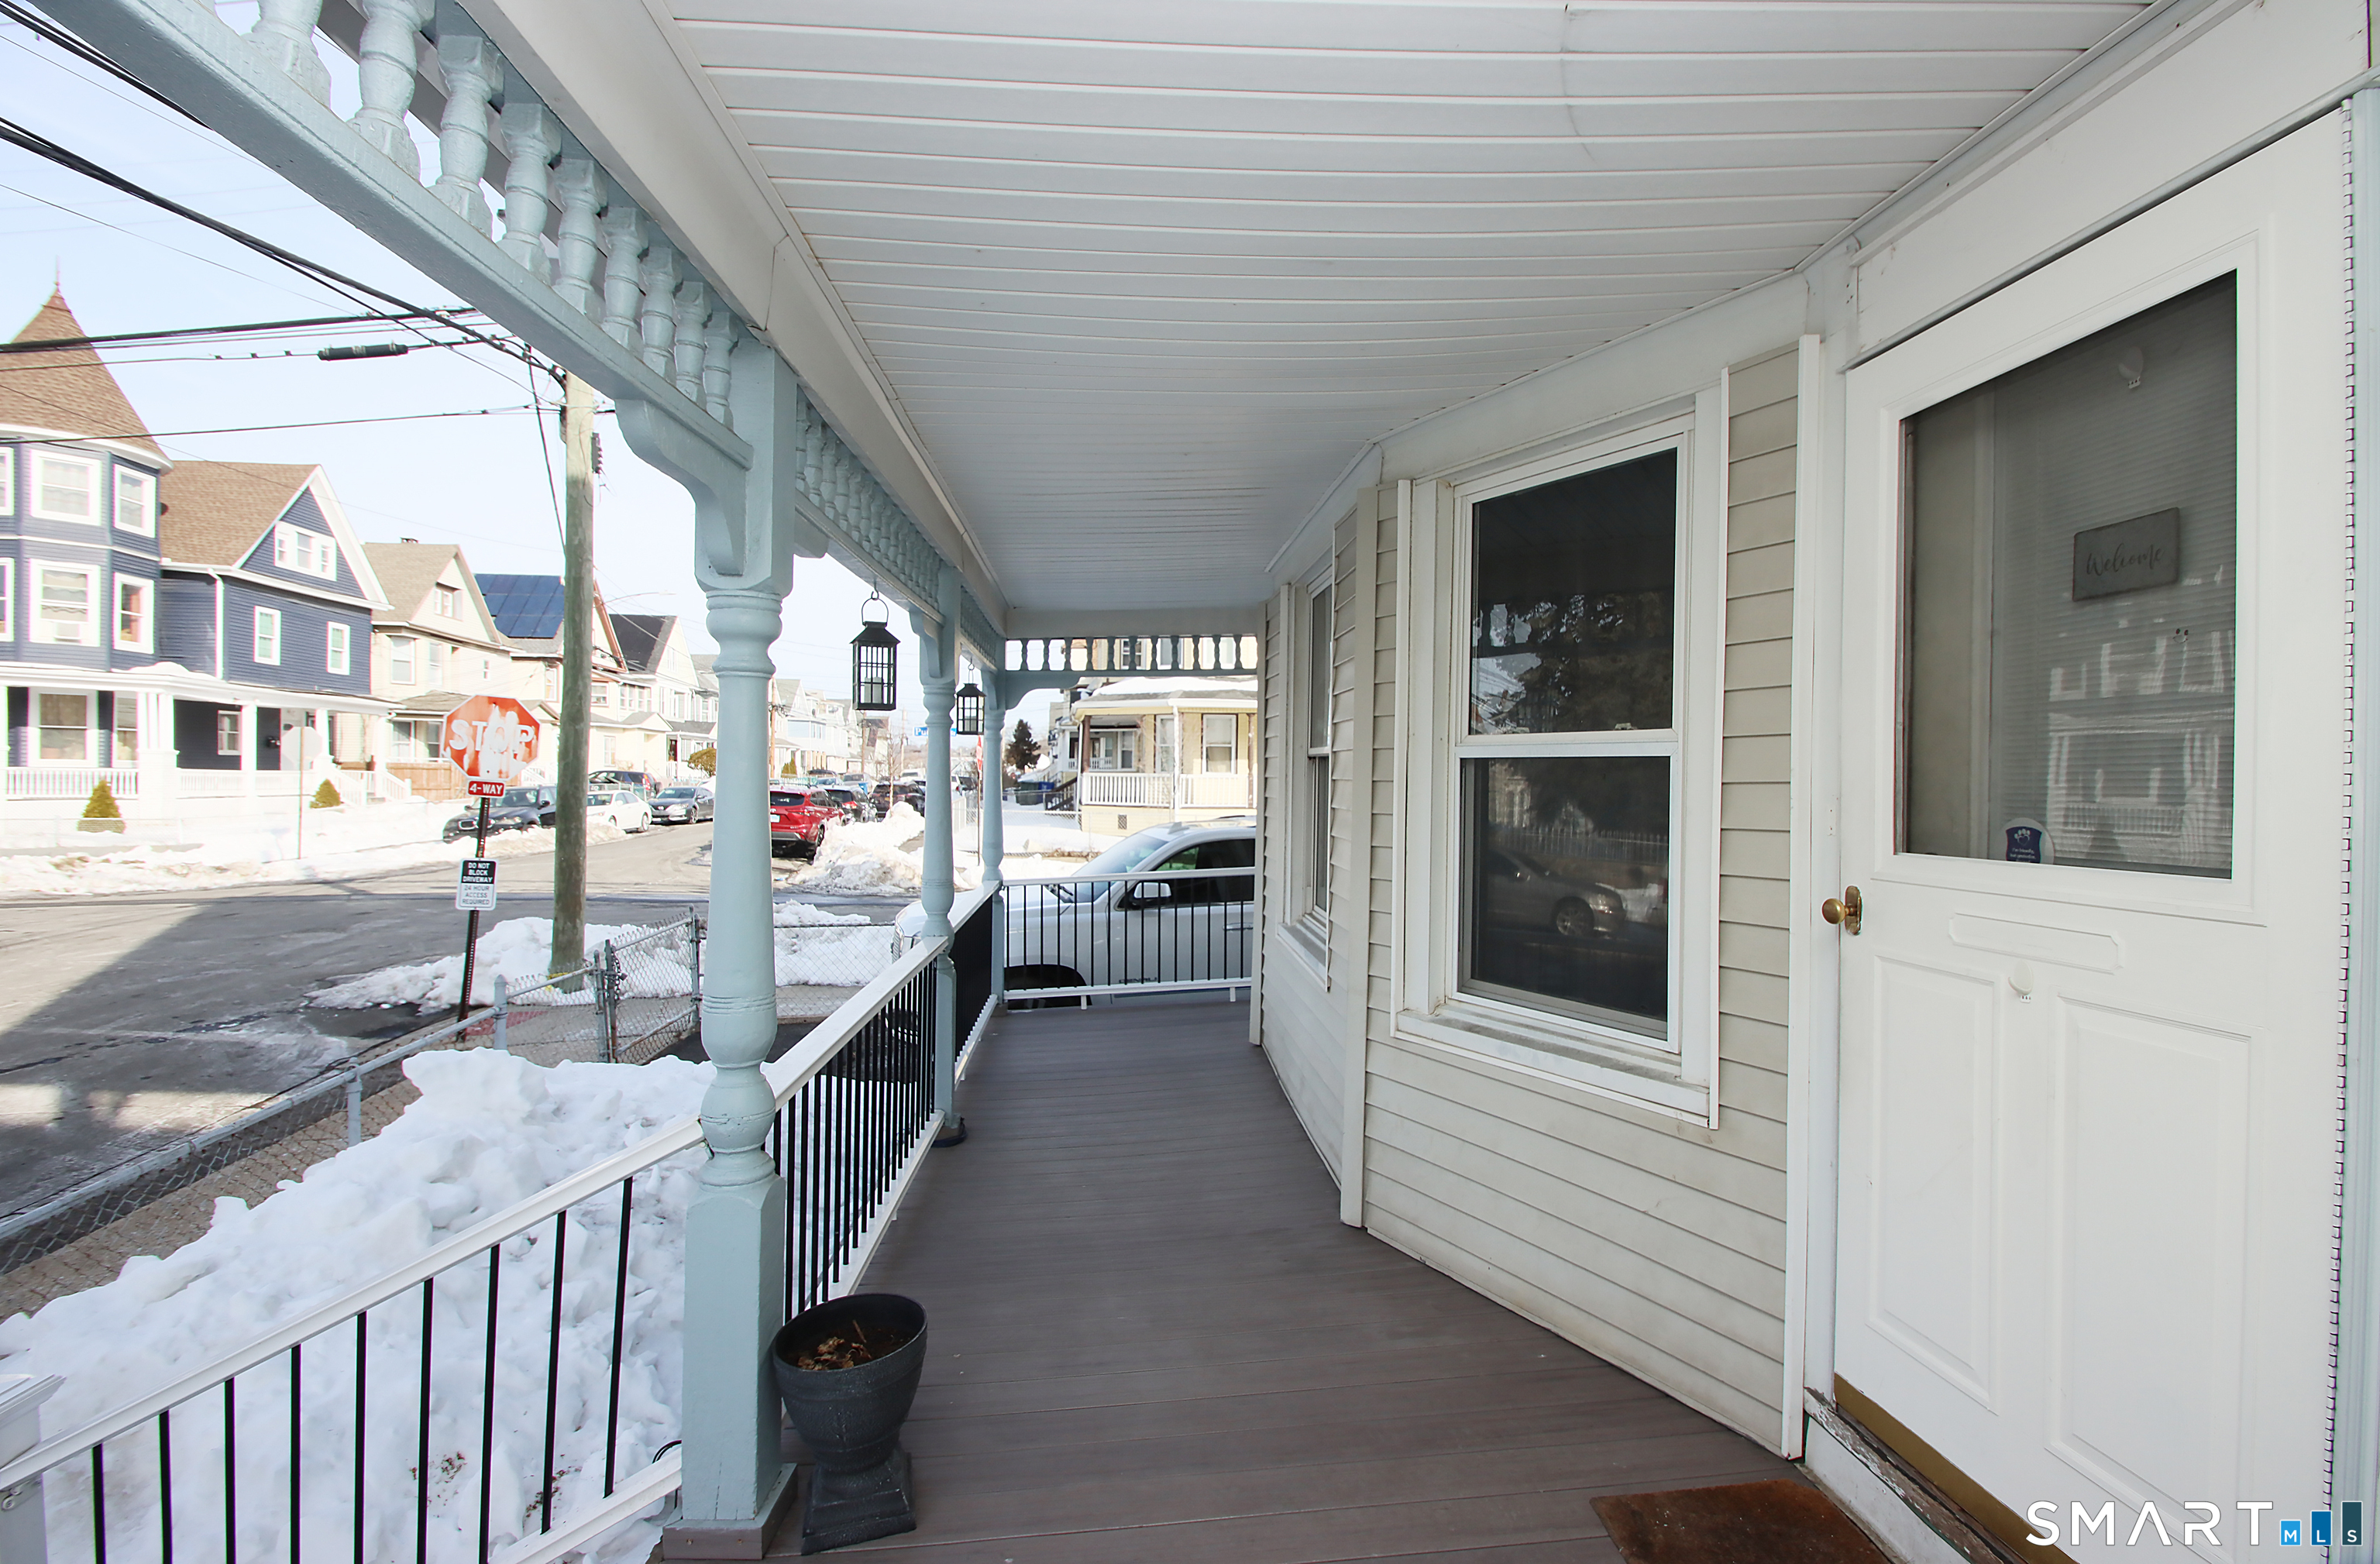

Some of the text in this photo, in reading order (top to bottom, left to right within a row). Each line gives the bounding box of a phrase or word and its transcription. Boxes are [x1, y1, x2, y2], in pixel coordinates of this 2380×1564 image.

[2086, 542, 2165, 576] Welcome
[449, 719, 535, 755] STOP
[469, 783, 503, 794] 4-WAY
